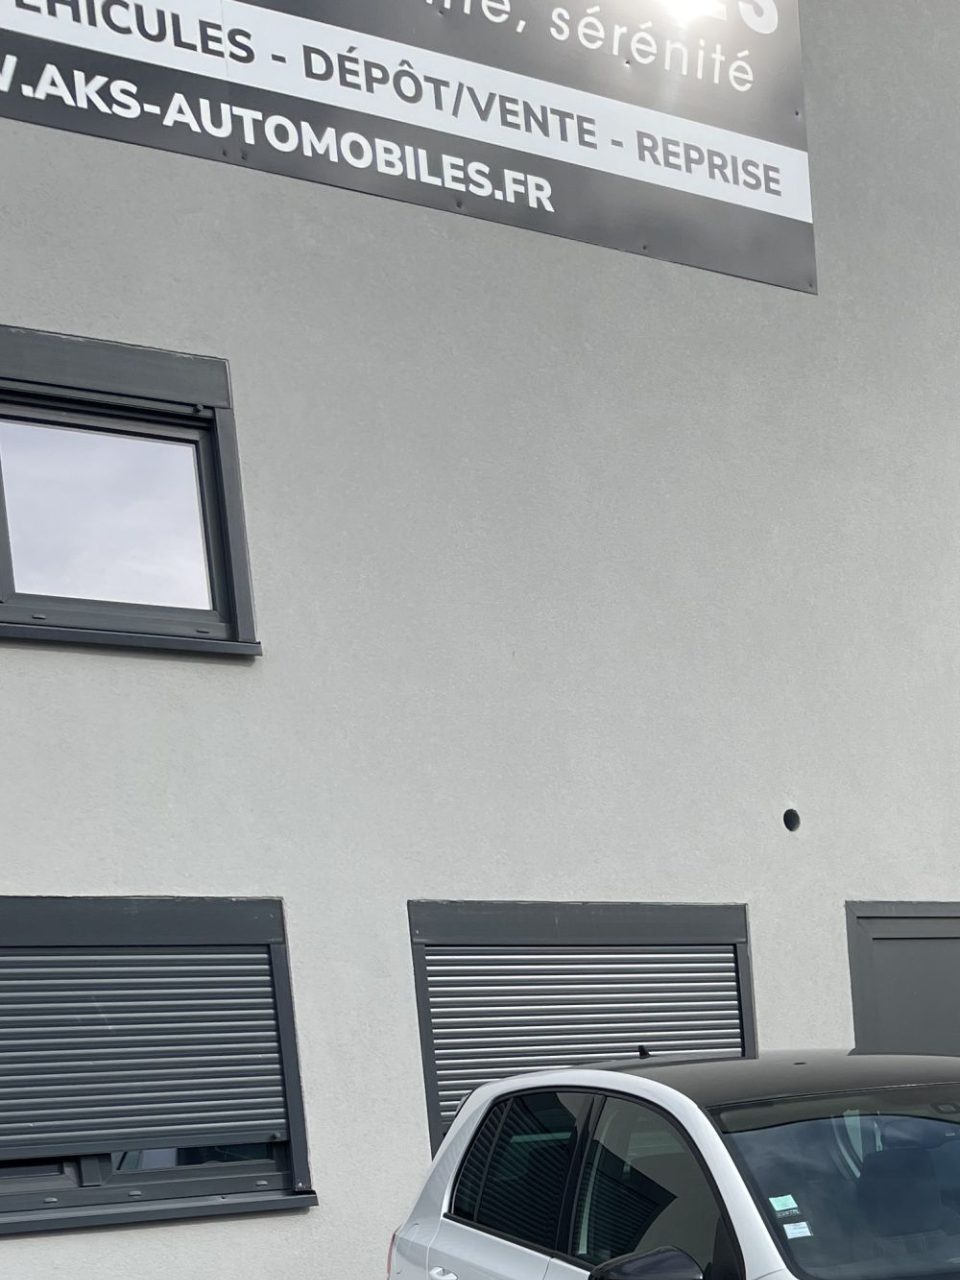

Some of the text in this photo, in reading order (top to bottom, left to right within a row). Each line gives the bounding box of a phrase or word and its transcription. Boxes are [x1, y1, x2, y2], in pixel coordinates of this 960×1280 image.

[550, 5, 754, 92] sérénité
[271, 54, 287, 63] -
[302, 45, 598, 150] DÉPÔT/VENTE
[610, 138, 624, 148] -
[635, 130, 782, 197] REPRISE
